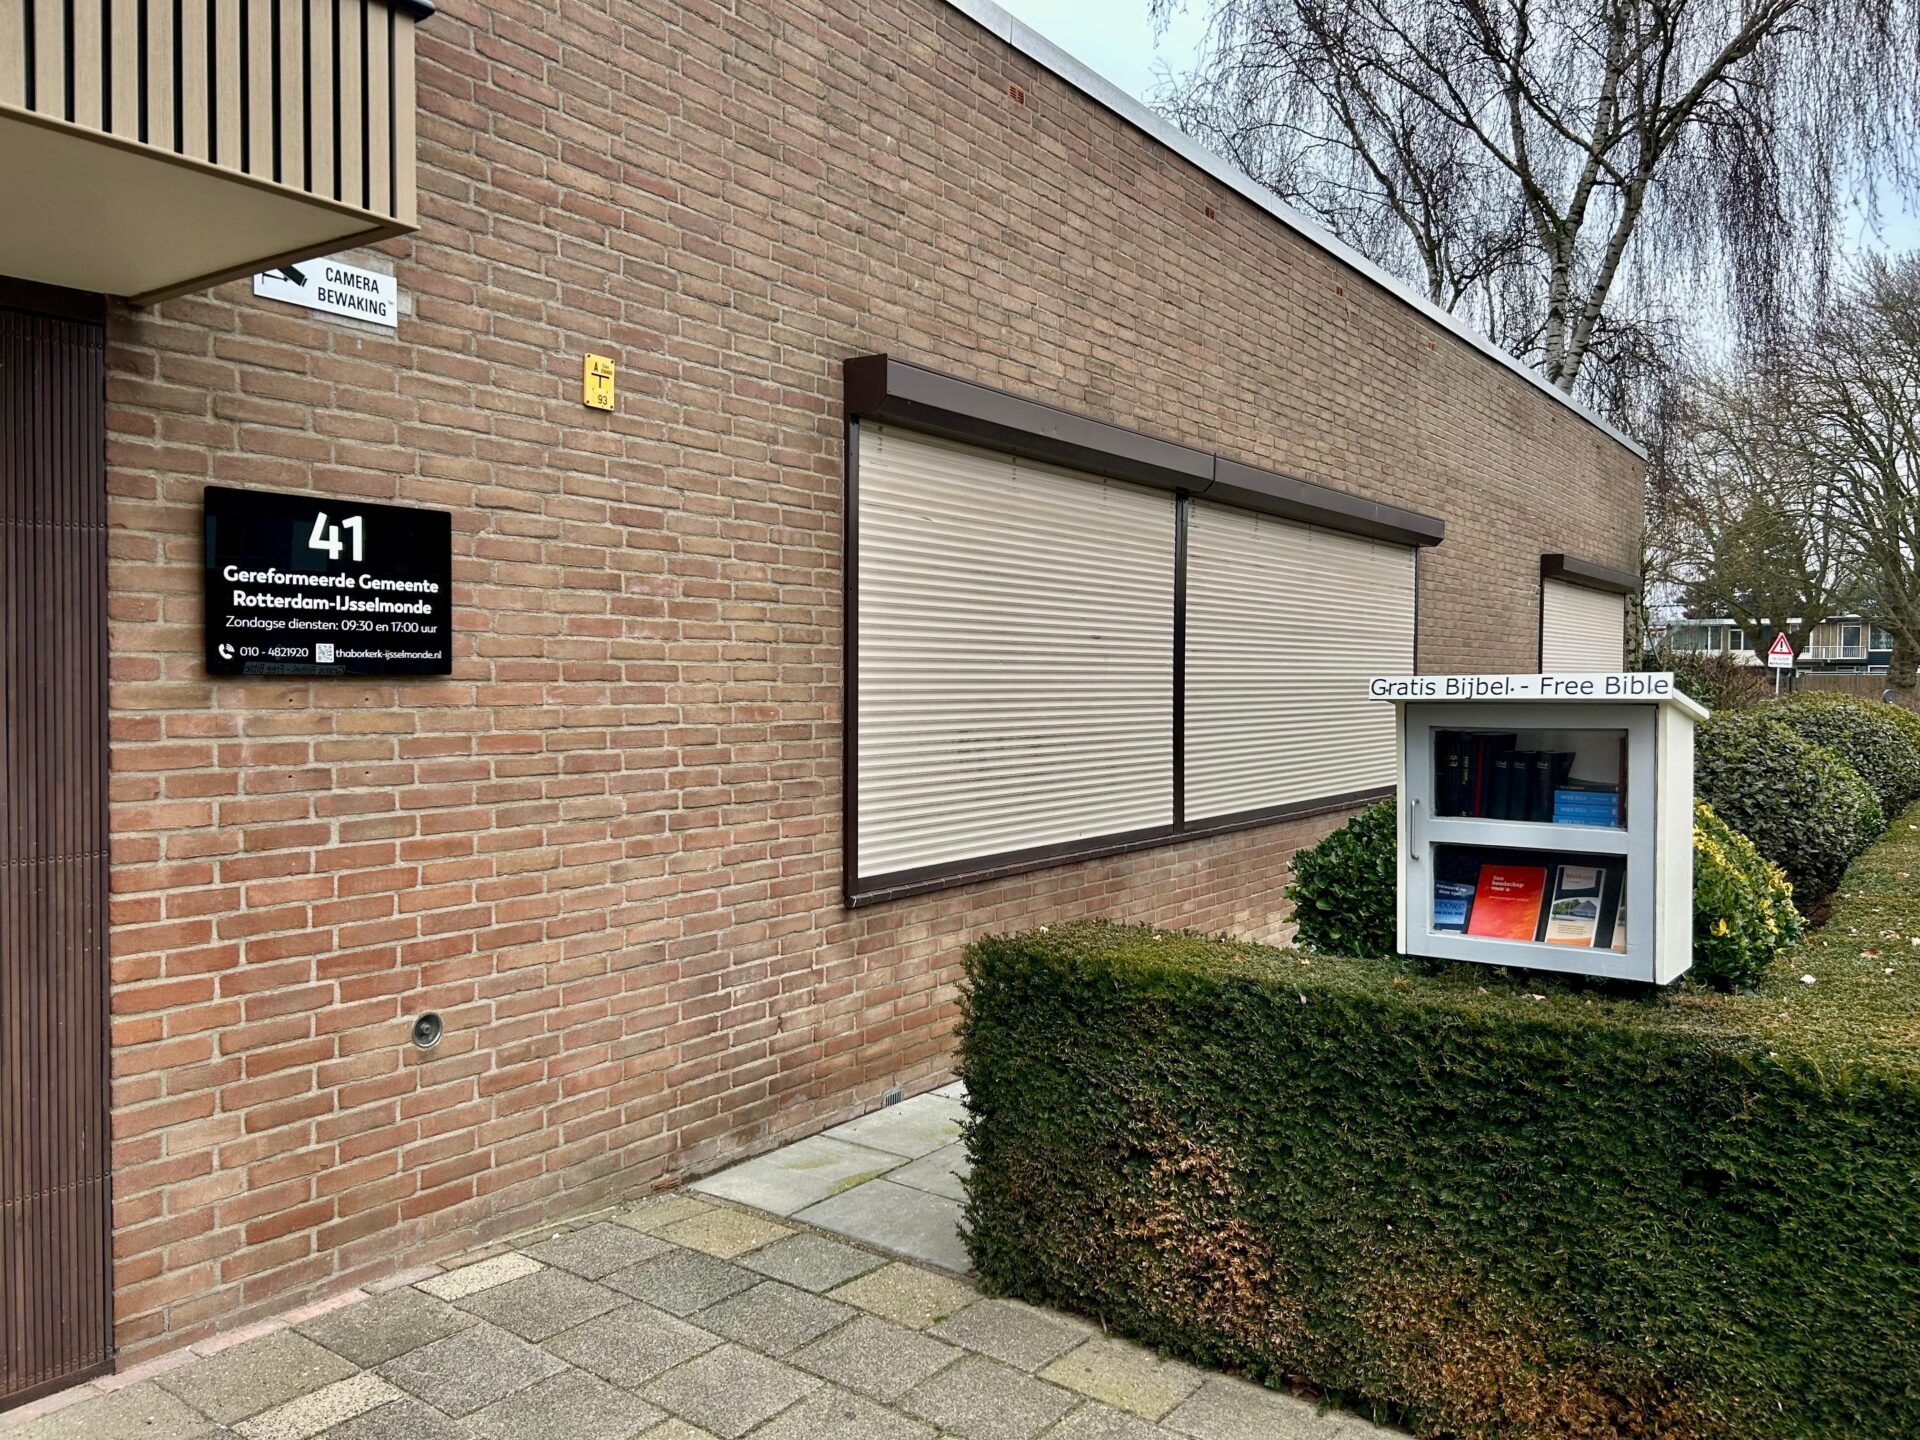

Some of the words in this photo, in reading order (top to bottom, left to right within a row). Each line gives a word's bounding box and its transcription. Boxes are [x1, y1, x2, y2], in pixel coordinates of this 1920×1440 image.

[325, 267, 379, 294] CAMERA
[317, 286, 387, 317] BEWAKING
[597, 394, 608, 406] 93
[308, 511, 363, 562] 41
[223, 564, 356, 589] Gereformeerde
[358, 573, 439, 593] Gemeente
[233, 589, 432, 615] Rotterdam-IJsselmonde
[225, 615, 286, 631] Zondagse
[288, 617, 339, 631] diensten:
[341, 619, 374, 632] 09:30
[375, 623, 389, 632] en
[390, 621, 419, 633] 17:00
[420, 626, 438, 634] uur
[239, 646, 260, 657] 010
[267, 647, 309, 658] 4821920
[335, 649, 442, 660] thaborkerk-ijsselmonde.nl
[1371, 678, 1436, 696] Gratis
[1540, 677, 1594, 695] Free
[1605, 675, 1669, 695] Bible
